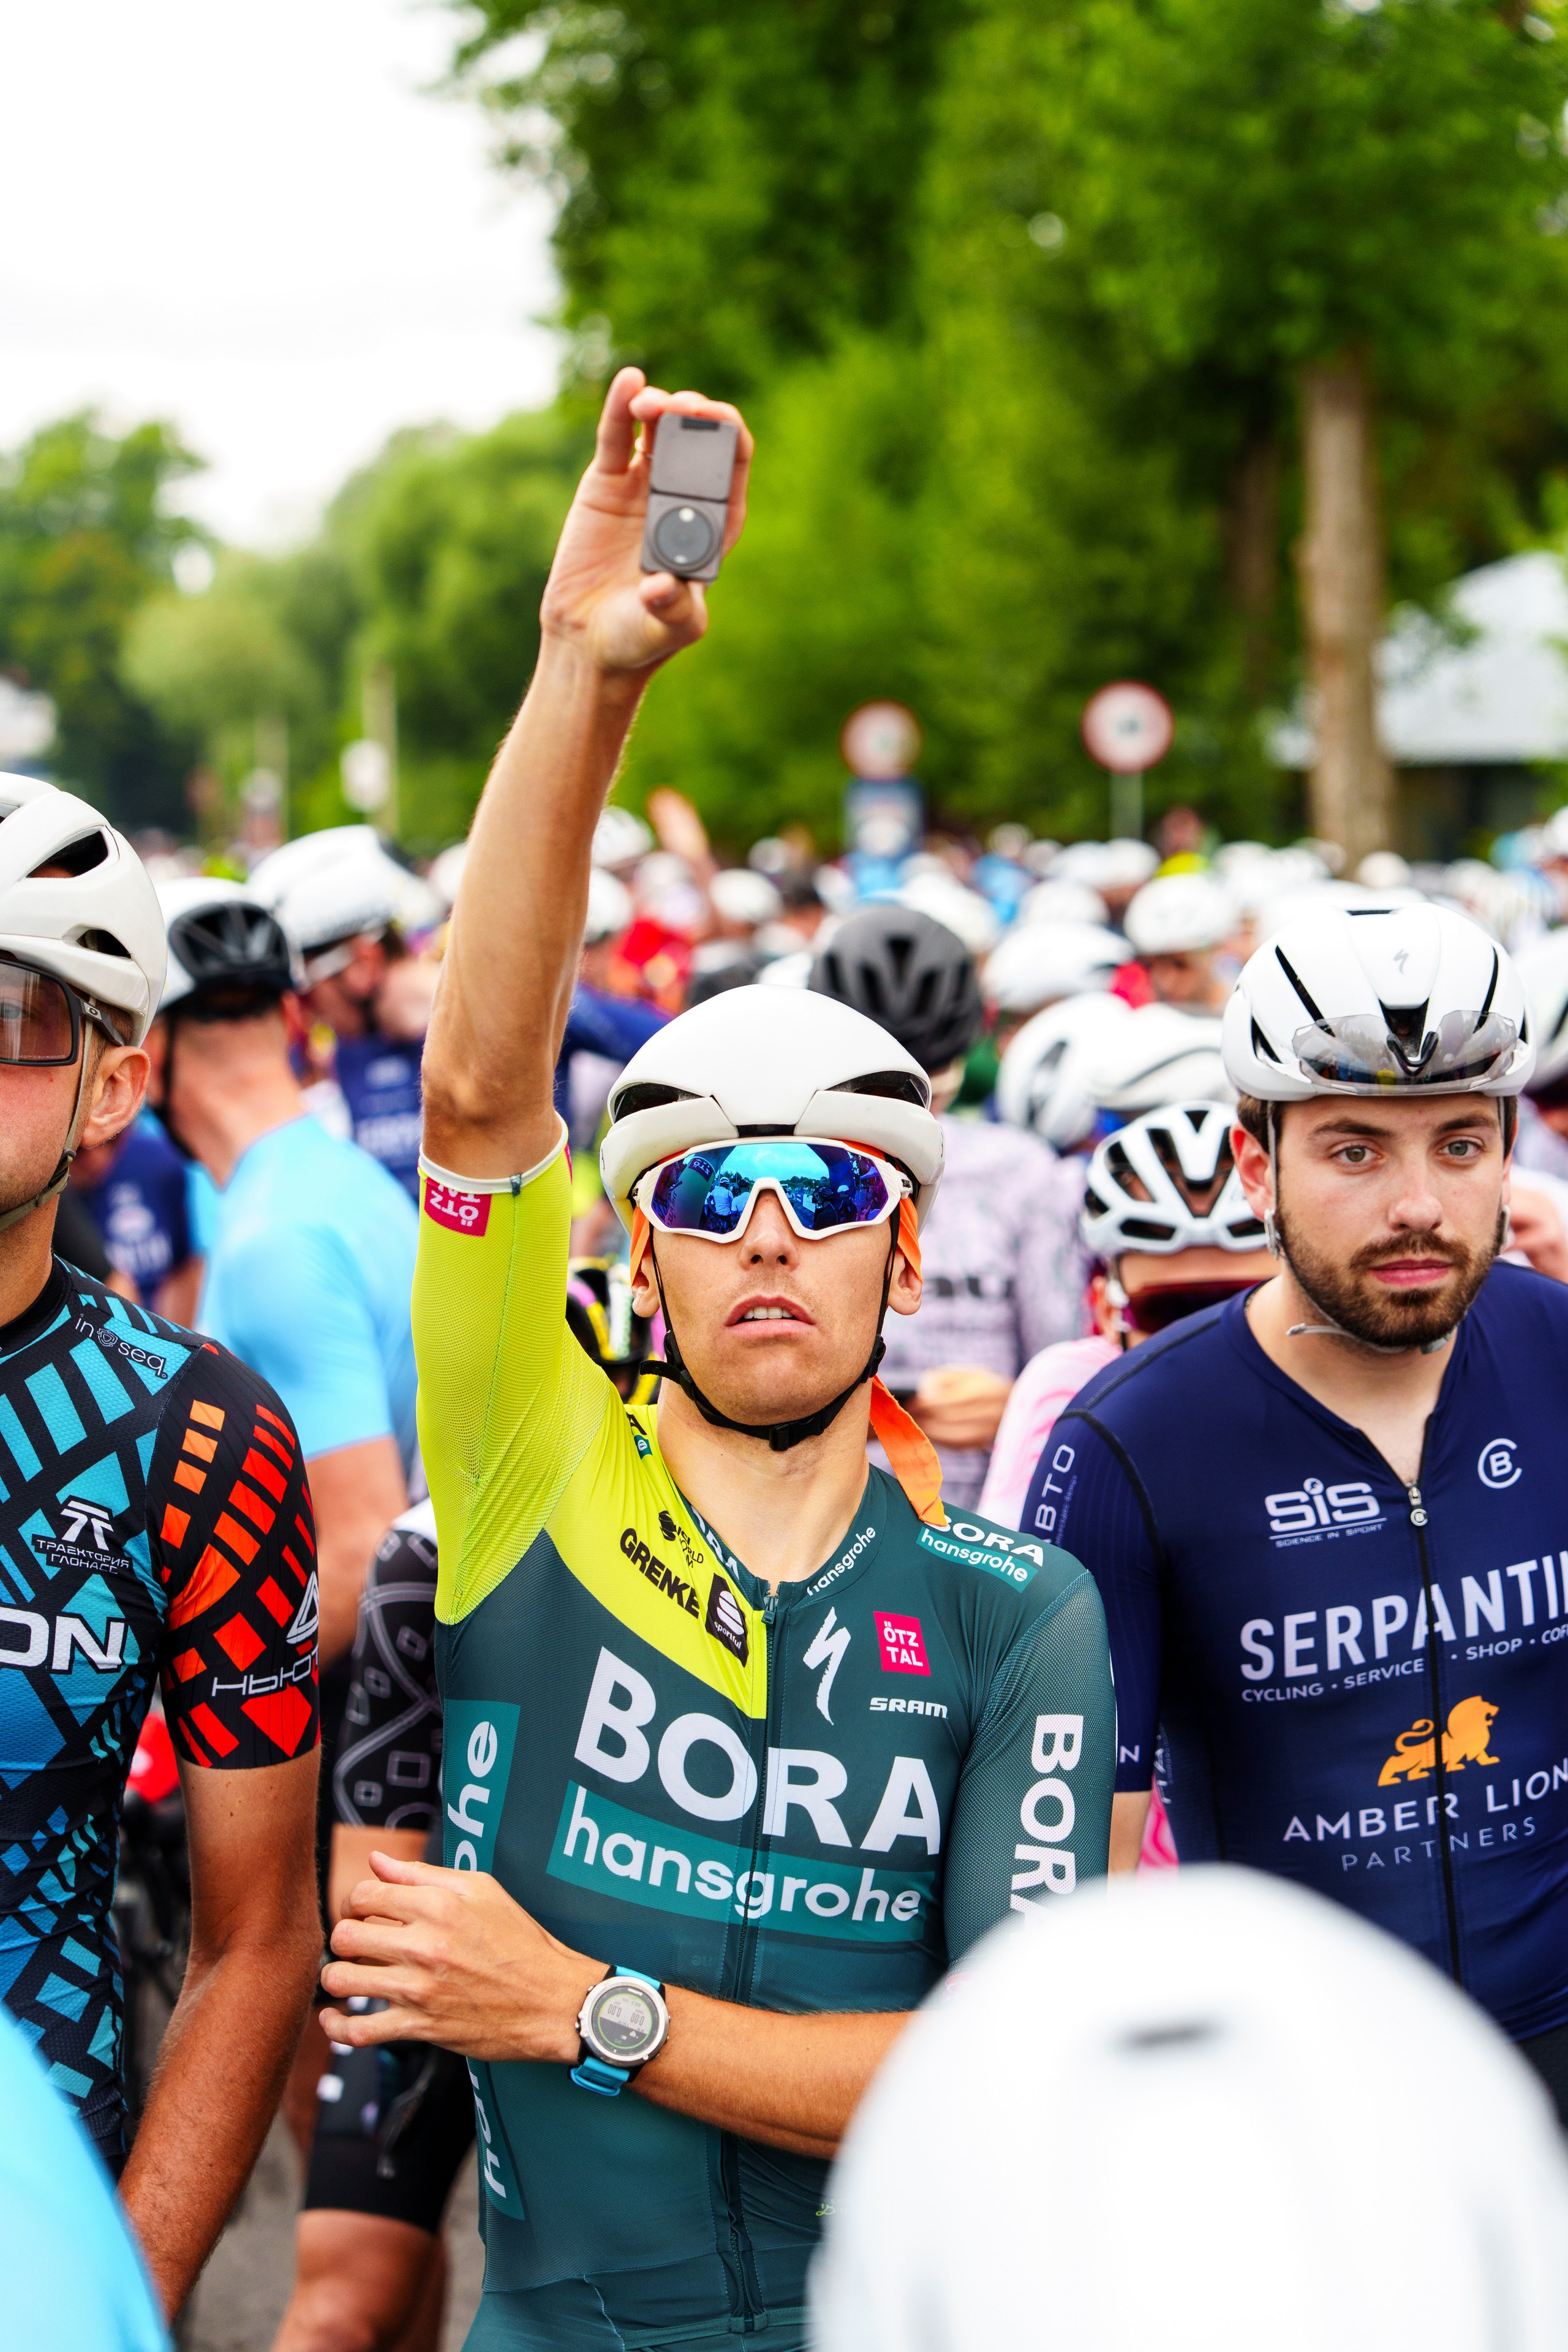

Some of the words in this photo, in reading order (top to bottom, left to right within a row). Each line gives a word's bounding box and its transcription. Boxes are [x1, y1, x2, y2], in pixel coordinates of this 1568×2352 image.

[429, 1190, 479, 1227] ÖTZ
[679, 1538, 704, 1564] ORLD
[1275, 1534, 1323, 1548] SCIENCE
[1327, 1531, 1340, 1540] IN
[1346, 1523, 1384, 1537] SPORT
[37, 1539, 129, 1569] ТРАЕКТОРИЯ
[51, 1553, 118, 1575] ГЛОНАСС
[921, 1528, 1028, 1581] hansgrohe
[620, 1528, 700, 1619] GRENKE
[714, 1621, 742, 1649] sportful
[884, 1621, 919, 1648] ÖTZ
[886, 1646, 924, 1667] TAL
[1242, 1683, 1324, 1702] CYCLING
[1343, 1658, 1425, 1689] SERVICE
[1466, 1637, 1523, 1660] SHOP
[869, 1697, 948, 1719] SRAM
[574, 1646, 941, 1855] BORA
[1282, 1793, 1460, 1842] AMBER
[1486, 1757, 1568, 1814] LION
[563, 1785, 921, 1922] hansgrohe
[1341, 1817, 1536, 1871] PARTNERS
